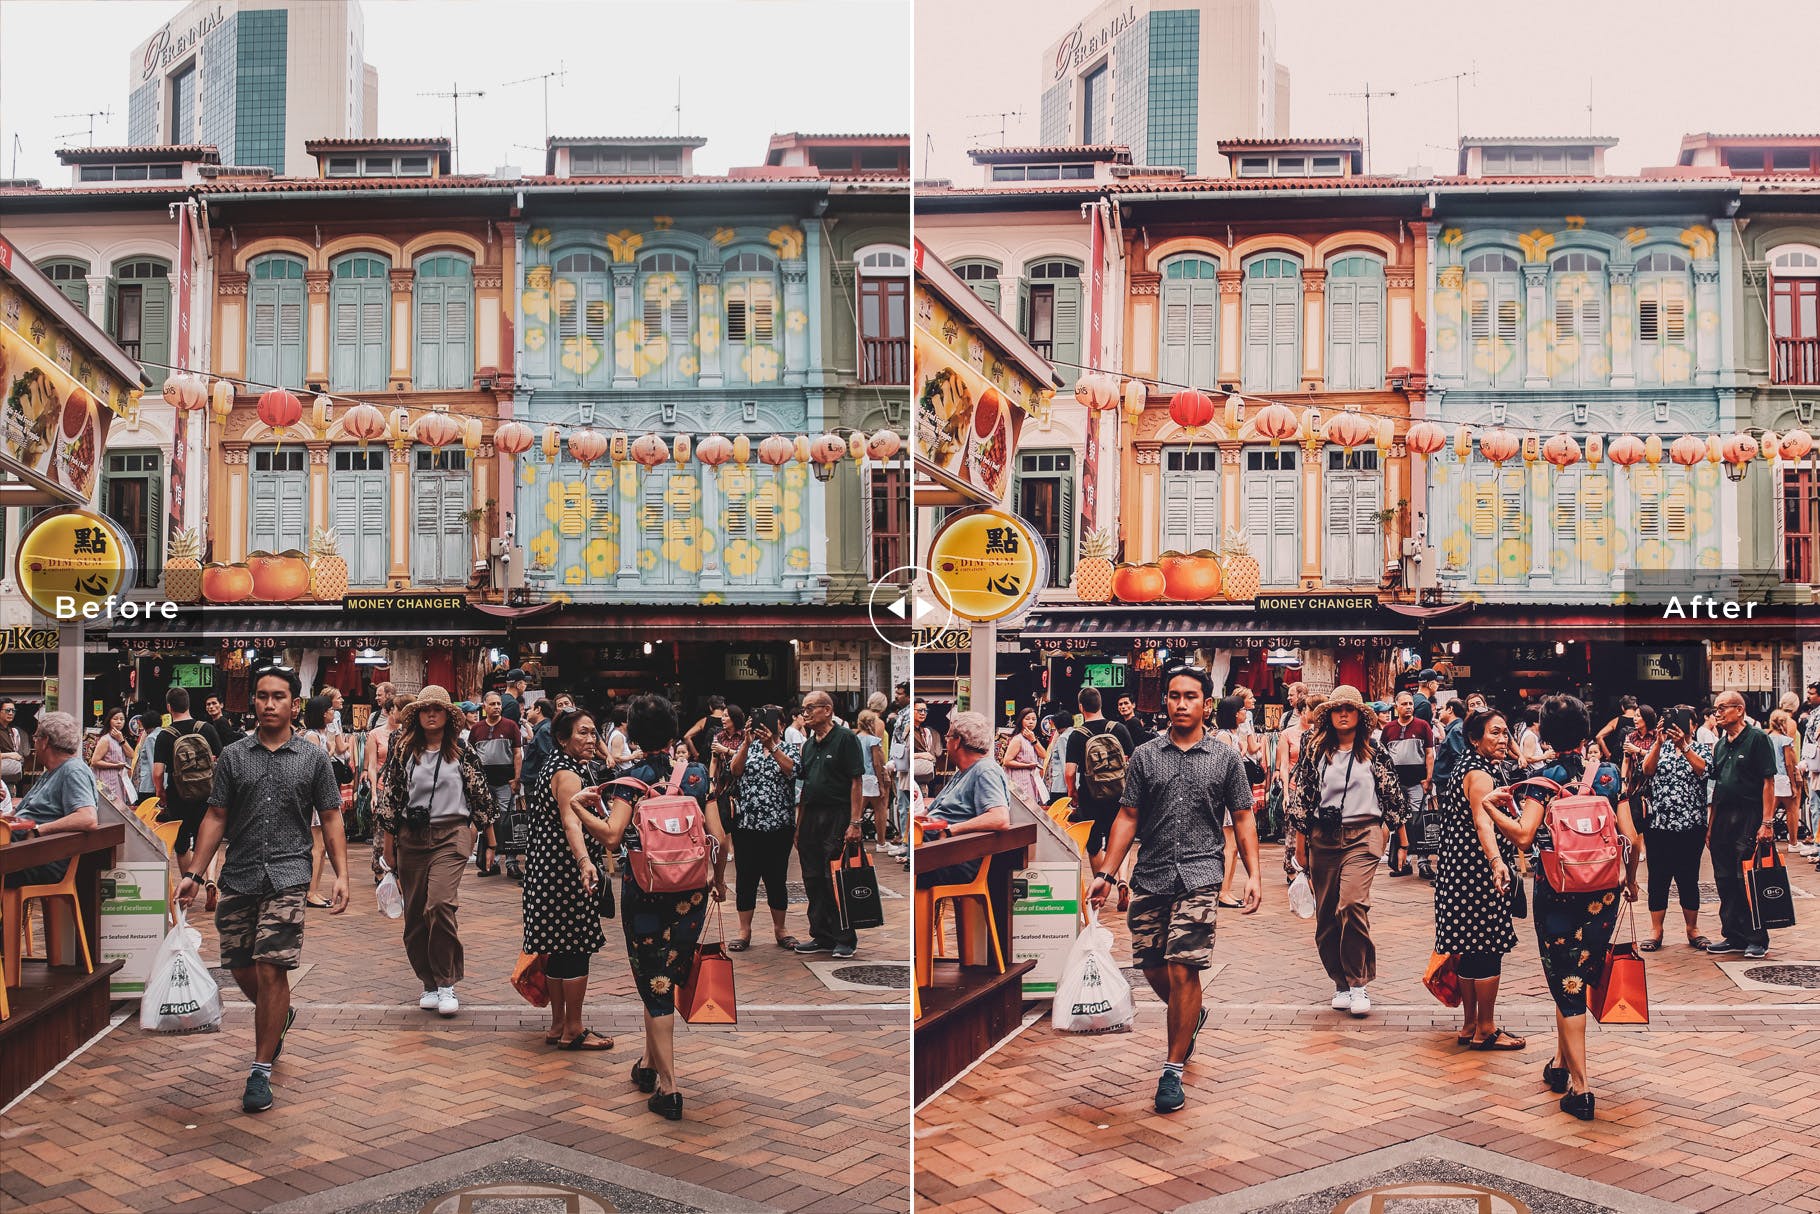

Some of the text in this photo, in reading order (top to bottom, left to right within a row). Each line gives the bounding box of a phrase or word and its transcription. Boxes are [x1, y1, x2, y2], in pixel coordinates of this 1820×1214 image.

[143, 6, 224, 81] PERENNIAL
[1055, 6, 1136, 81] PERENNIAL
[73, 526, 107, 555] 點
[985, 526, 1019, 555] 點
[48, 558, 72, 567] DIM
[960, 558, 984, 567] DIM
[74, 573, 108, 596] 心
[986, 573, 1020, 596] 心
[348, 598, 461, 609] MONEY CHANGER
[1260, 598, 1373, 609] MONEY CHANGER
[122, 639, 130, 648] 3
[221, 638, 229, 648] 3
[233, 637, 250, 648] for
[334, 637, 352, 648] for
[426, 637, 434, 647] 3
[1034, 639, 1042, 648] 3
[1133, 638, 1141, 648] 3
[1145, 637, 1162, 648] for
[1246, 637, 1264, 648] for
[1338, 637, 1346, 647] 3
[116, 904, 123, 912] of
[123, 904, 153, 912] Excellence
[1028, 904, 1035, 912] of
[1035, 904, 1065, 912] Excellence
[170, 1000, 199, 1013] HOUR
[1082, 1000, 1111, 1013] HOUR
